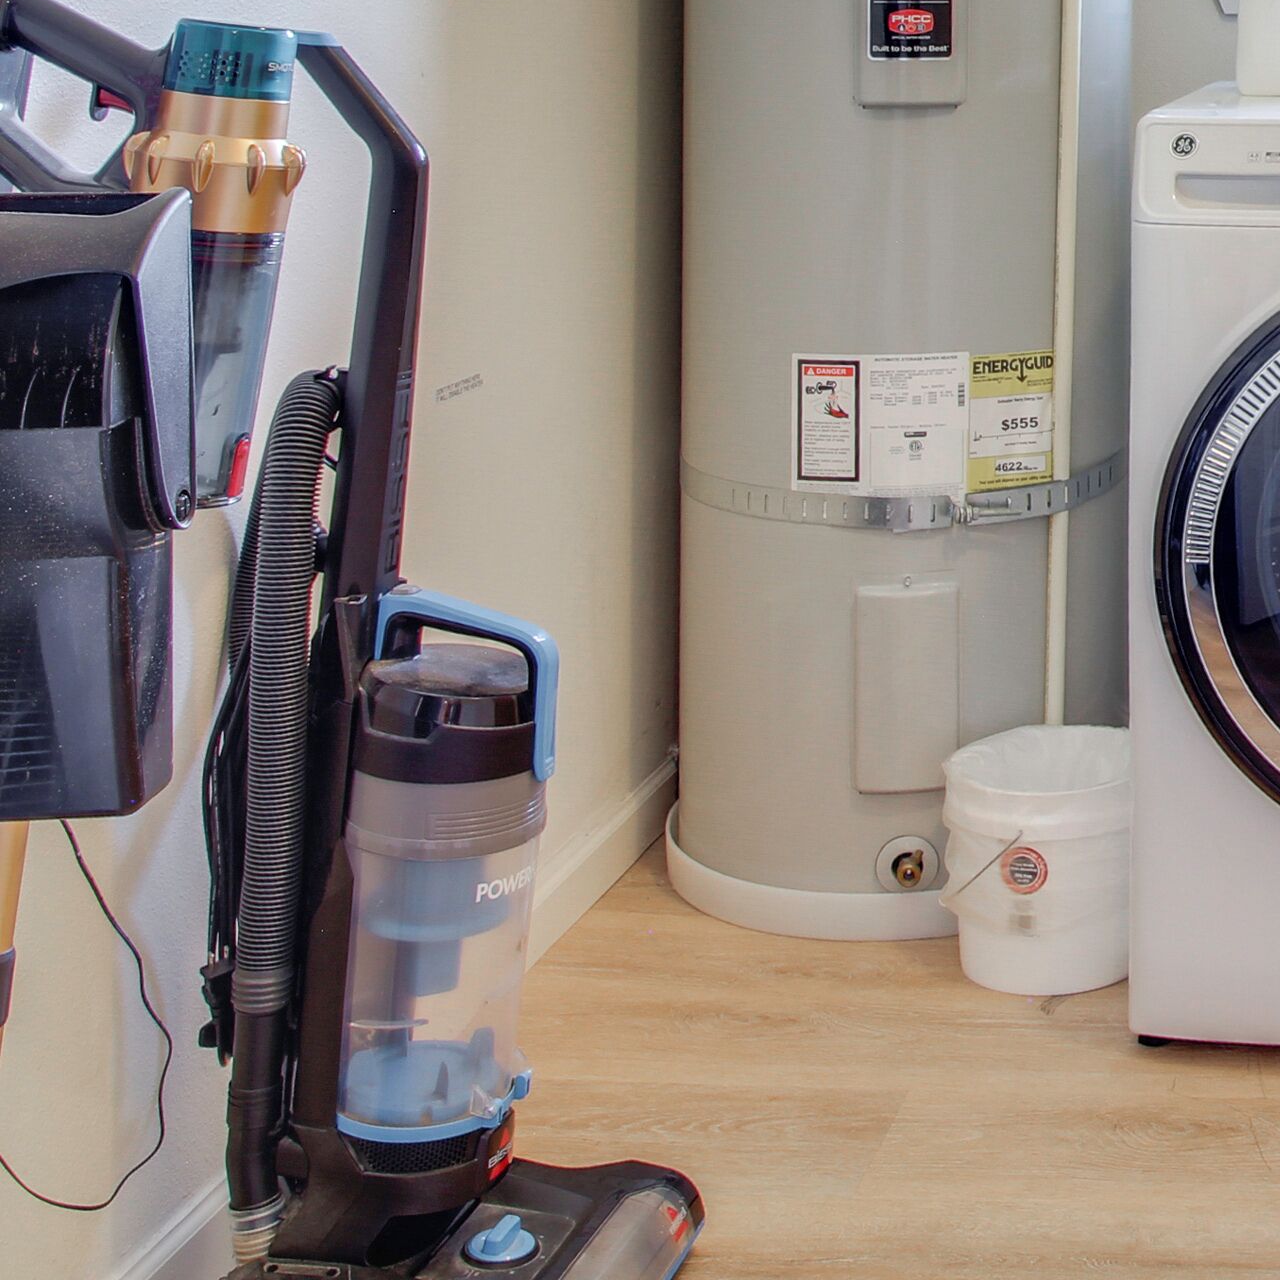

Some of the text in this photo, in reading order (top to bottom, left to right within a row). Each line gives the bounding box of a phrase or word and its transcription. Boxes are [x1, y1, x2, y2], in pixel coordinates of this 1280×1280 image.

[892, 15, 931, 23] PHCC
[973, 356, 1053, 377] ENERGYGUID
[1001, 417, 1039, 431] $555
[995, 461, 1023, 472] 4622
